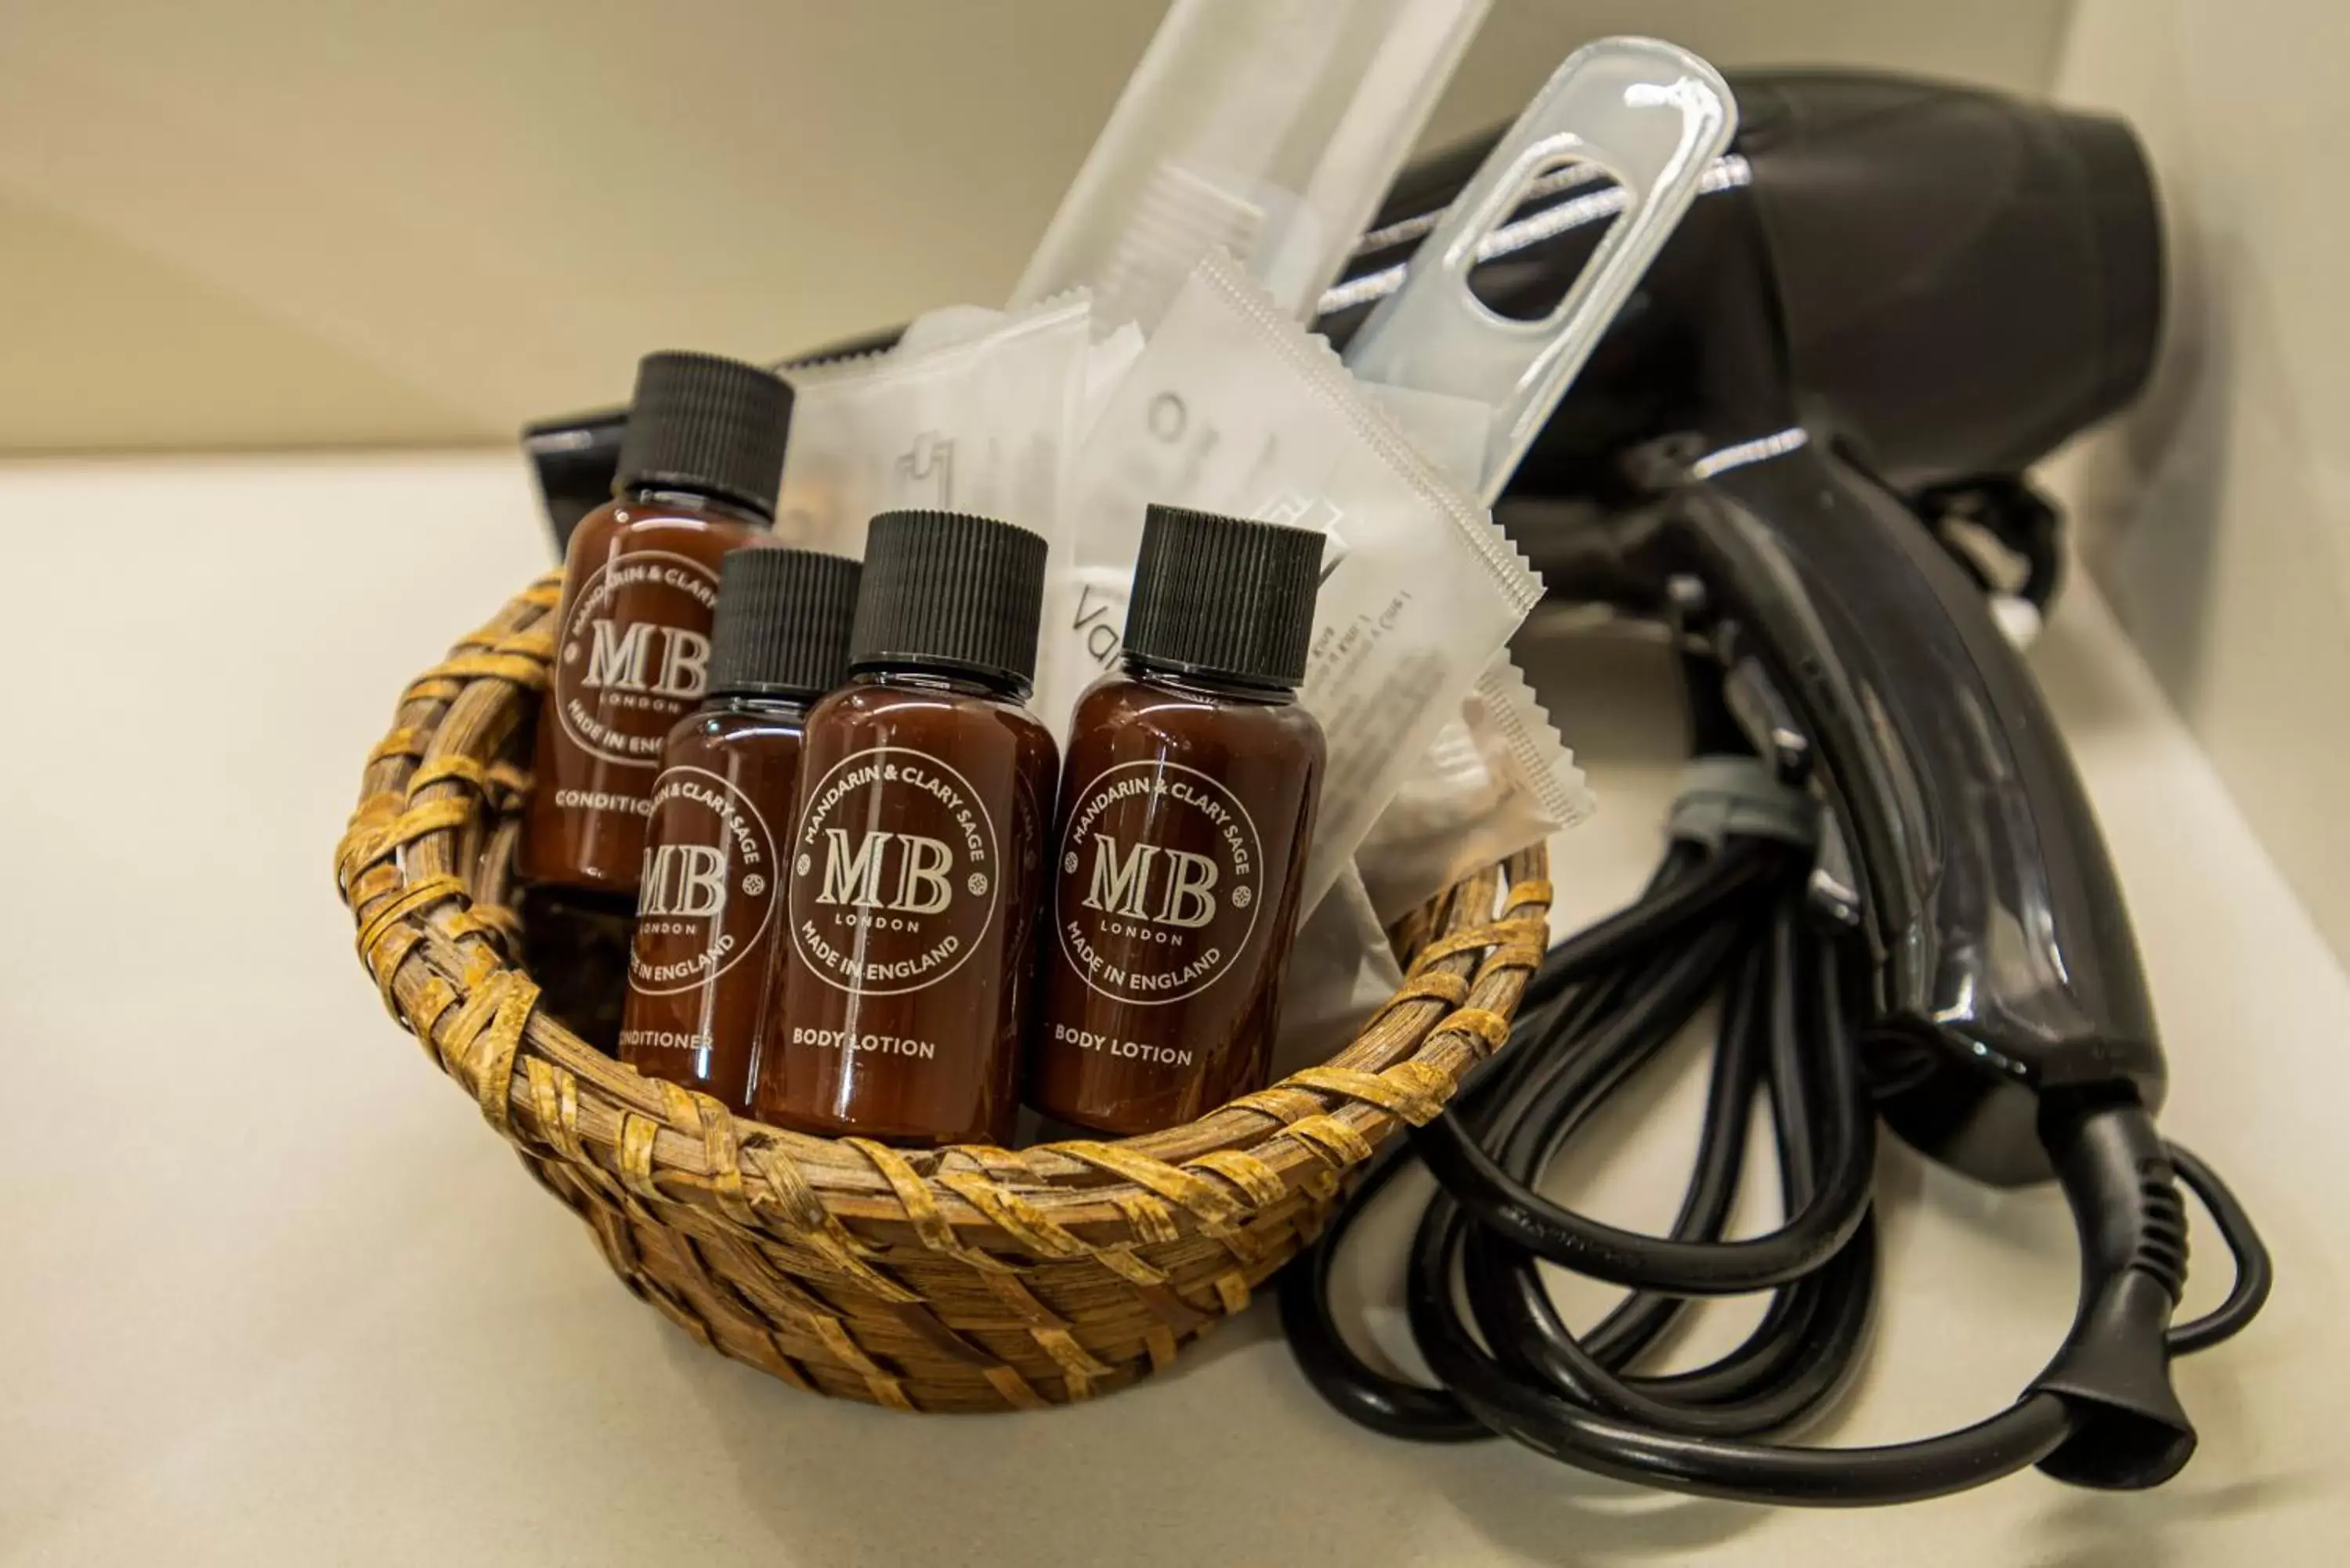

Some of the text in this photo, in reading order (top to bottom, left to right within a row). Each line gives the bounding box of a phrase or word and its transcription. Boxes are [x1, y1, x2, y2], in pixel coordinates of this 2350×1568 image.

[580, 618, 711, 699] MB
[567, 698, 603, 740] MADE
[602, 729, 625, 750] IN
[599, 692, 680, 714] LONDON
[682, 782, 736, 818] CLARY
[729, 816, 761, 865] SAGE
[804, 764, 880, 845] MANDARIN
[884, 764, 898, 781] &
[901, 766, 964, 810] CLARY
[956, 808, 985, 862] SAGE
[1073, 776, 1150, 844] MANDARIN
[1154, 779, 1169, 796] &
[1171, 782, 1231, 826] CLARY
[1223, 825, 1250, 876] SAGE
[635, 844, 728, 917] MB
[815, 828, 953, 915] MB
[1081, 833, 1219, 928] MB
[802, 919, 959, 981] MADE IN ENGLAND
[835, 913, 920, 933] LONDON
[1067, 920, 1221, 991] MADE IN ENGLAND
[1101, 919, 1183, 946] LONDON
[654, 934, 735, 981] ENGLAND
[793, 1028, 935, 1060] BODY LOTION
[1054, 1024, 1192, 1066] BODY LOTION
